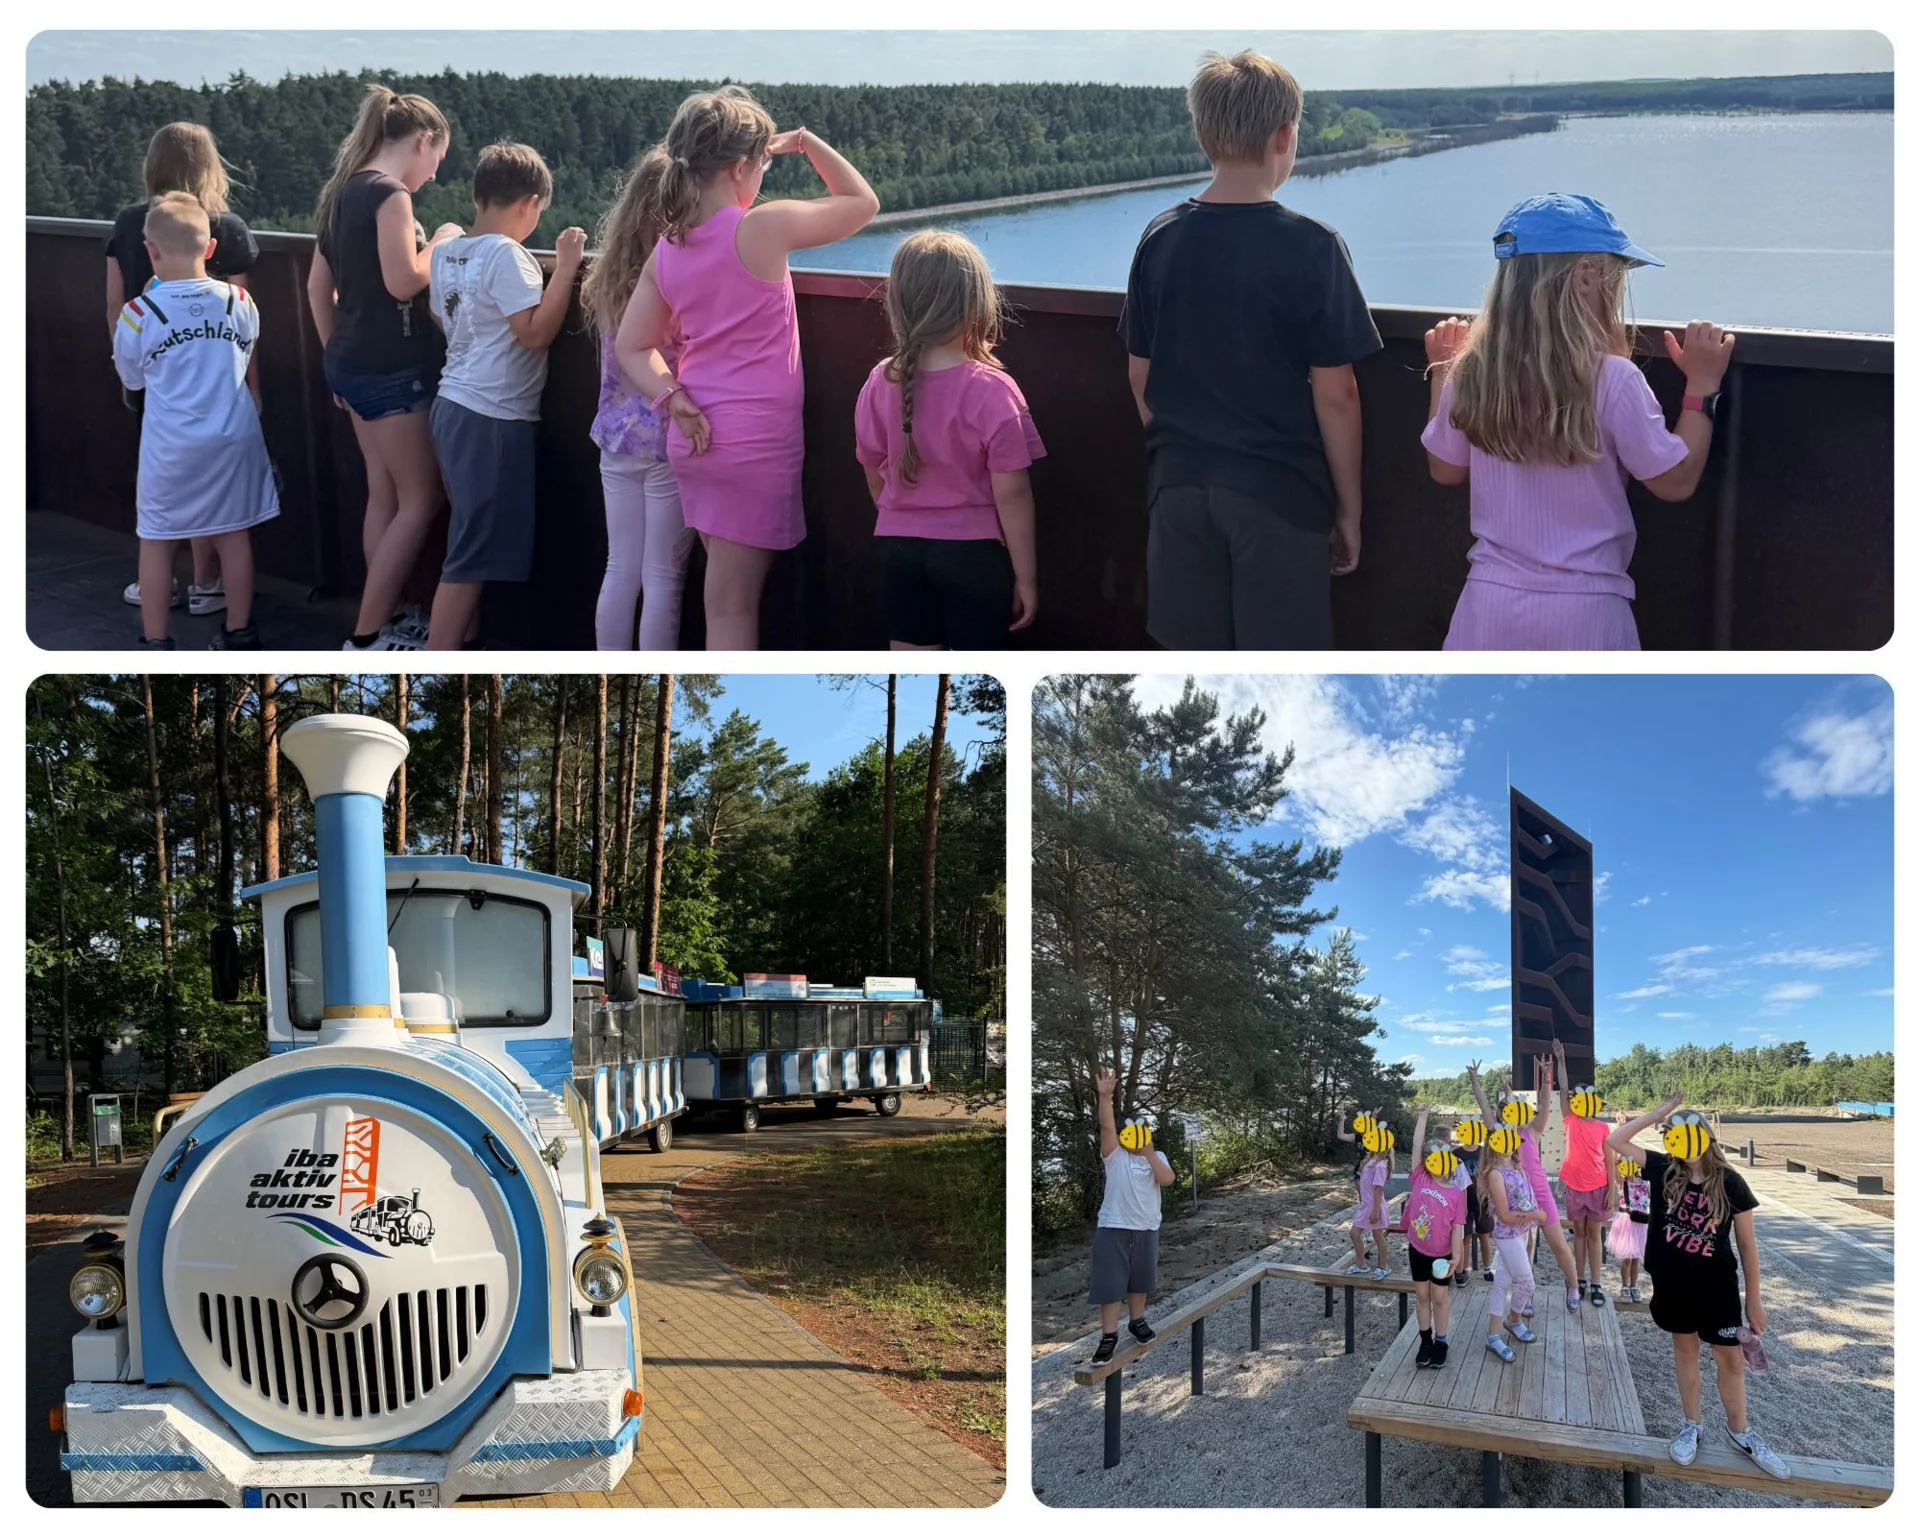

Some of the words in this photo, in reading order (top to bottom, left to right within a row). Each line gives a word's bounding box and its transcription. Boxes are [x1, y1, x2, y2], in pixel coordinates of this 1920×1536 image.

[151, 319, 252, 362] utschland
[283, 1149, 339, 1168] iba
[249, 1169, 337, 1188] aktiv
[245, 1191, 336, 1209] tours
[1665, 1227, 1716, 1257] VIBE
